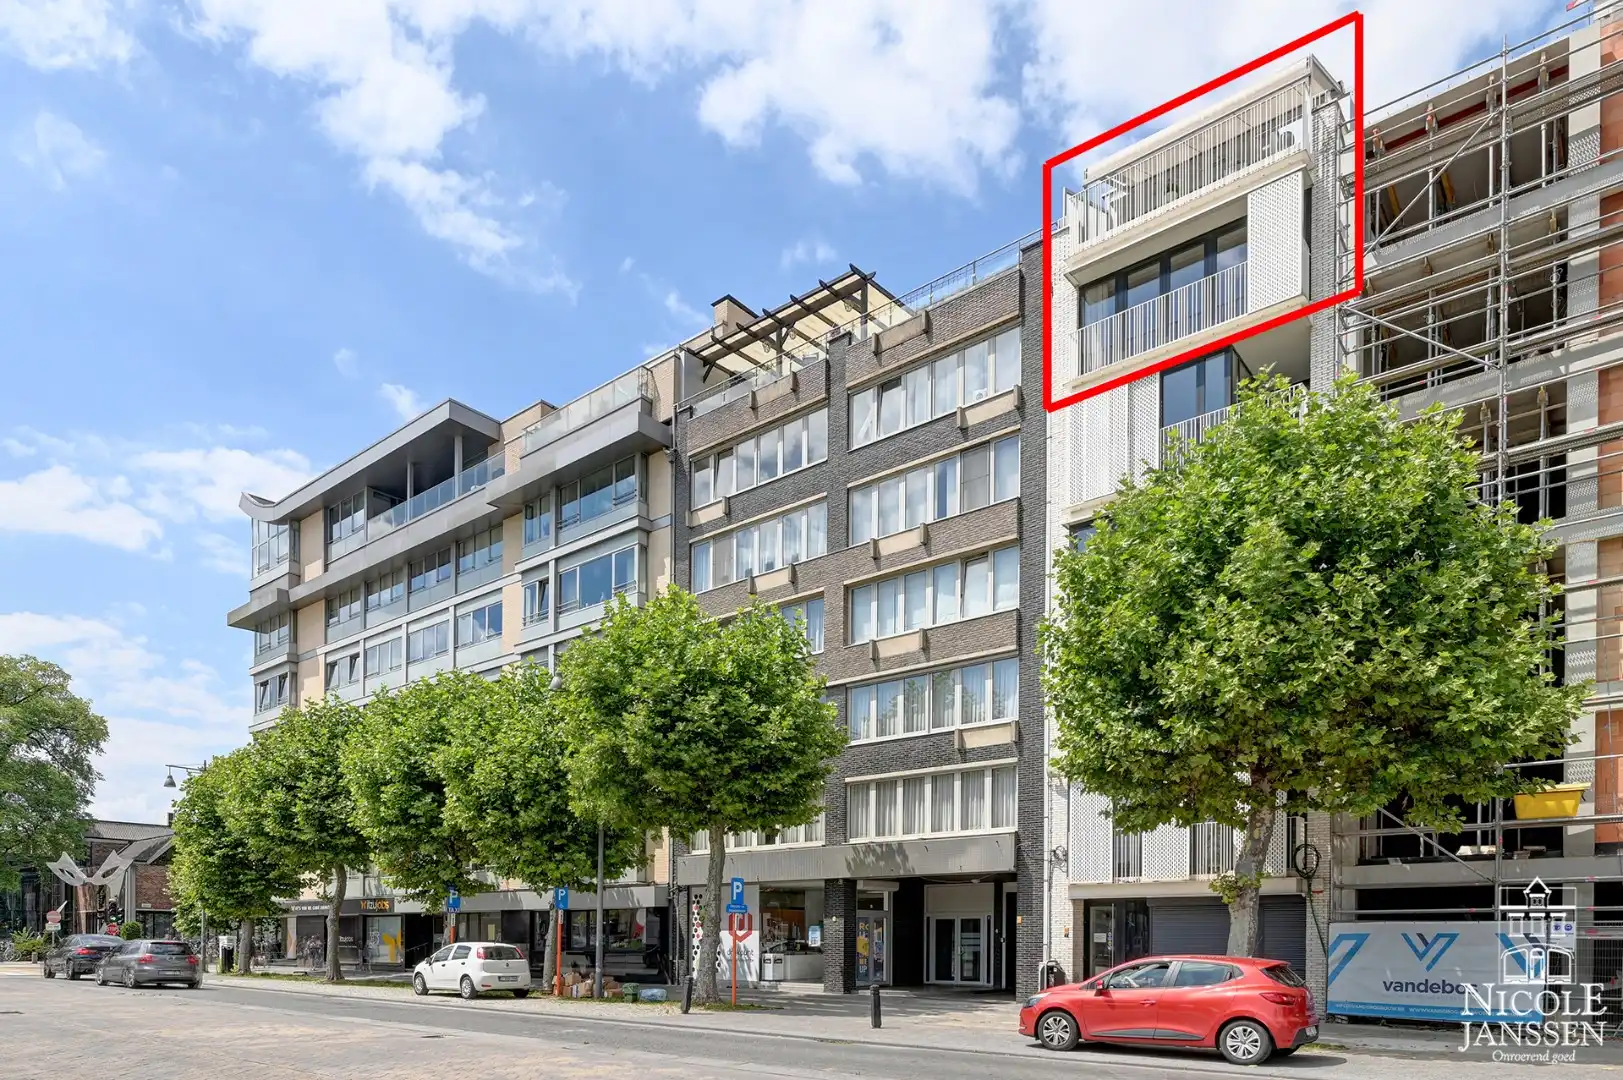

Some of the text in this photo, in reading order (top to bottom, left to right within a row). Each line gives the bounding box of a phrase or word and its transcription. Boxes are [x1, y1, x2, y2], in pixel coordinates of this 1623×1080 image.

[450, 889, 459, 904] P
[558, 889, 566, 901] P
[733, 882, 742, 900] P
